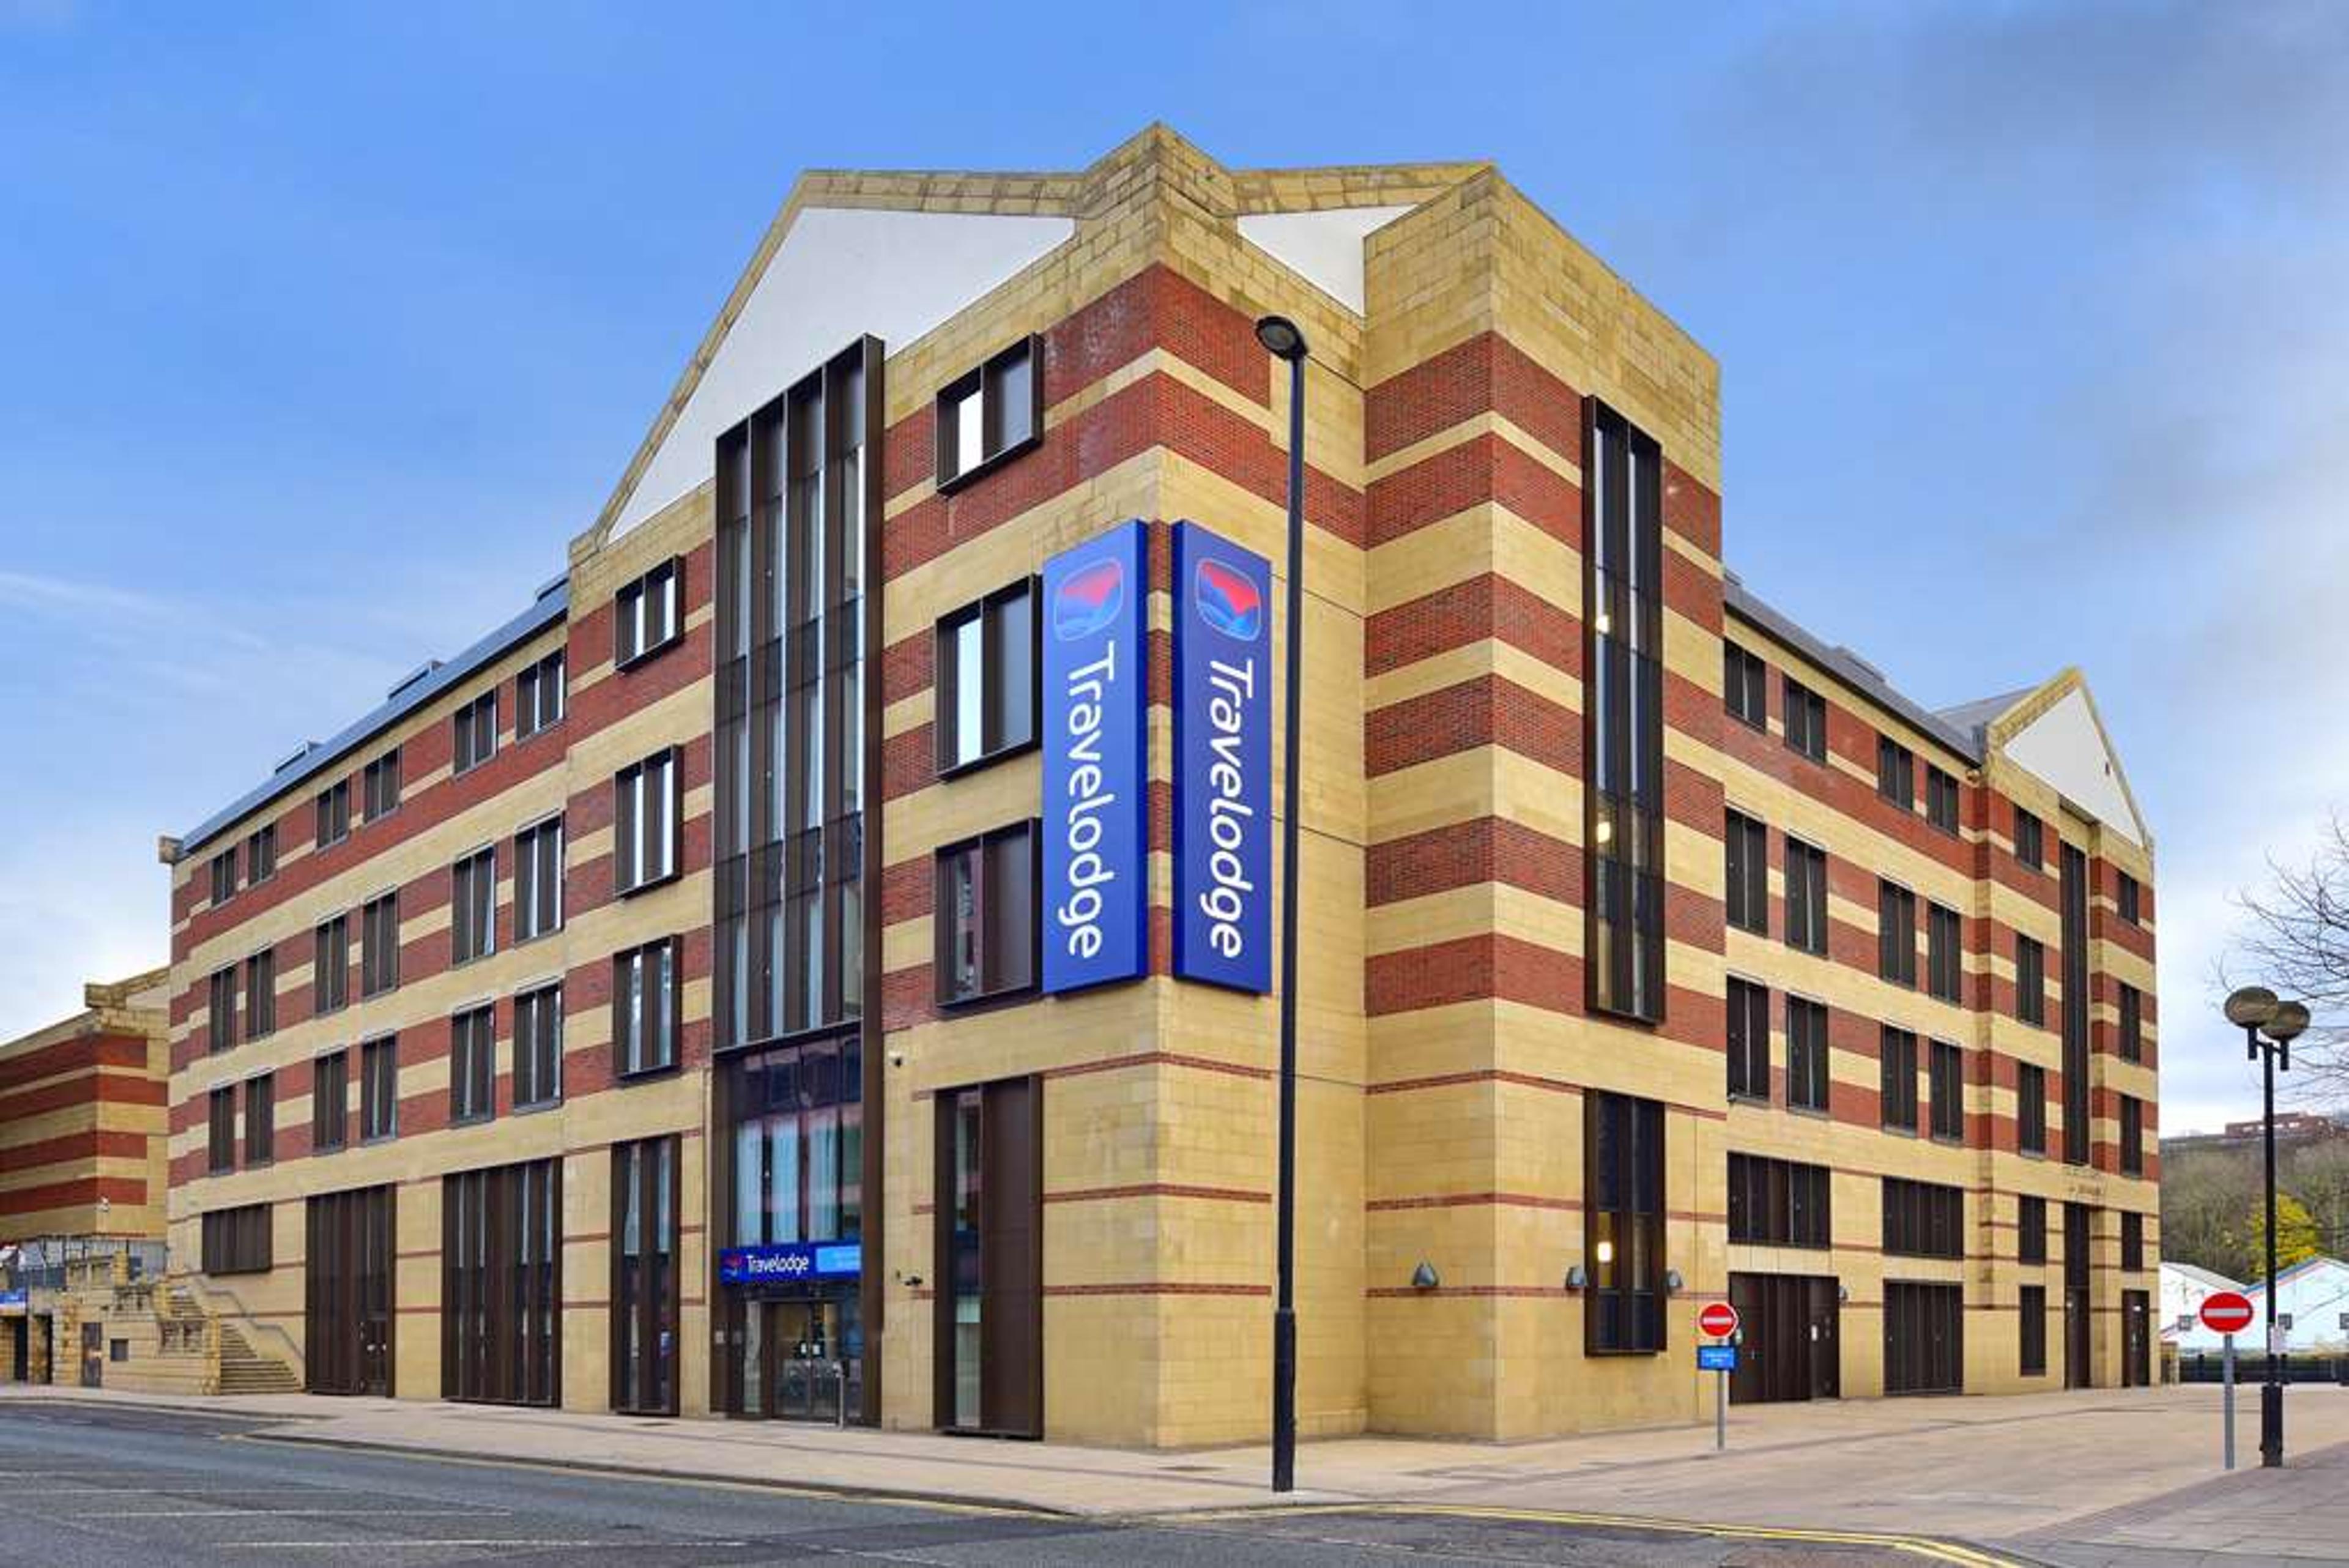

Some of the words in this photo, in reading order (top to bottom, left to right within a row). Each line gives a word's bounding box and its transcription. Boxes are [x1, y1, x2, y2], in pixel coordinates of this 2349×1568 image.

[1058, 641, 1115, 958] Travelodge
[1200, 658, 1253, 958] Travelodge
[746, 1254, 809, 1276] Travelodge
